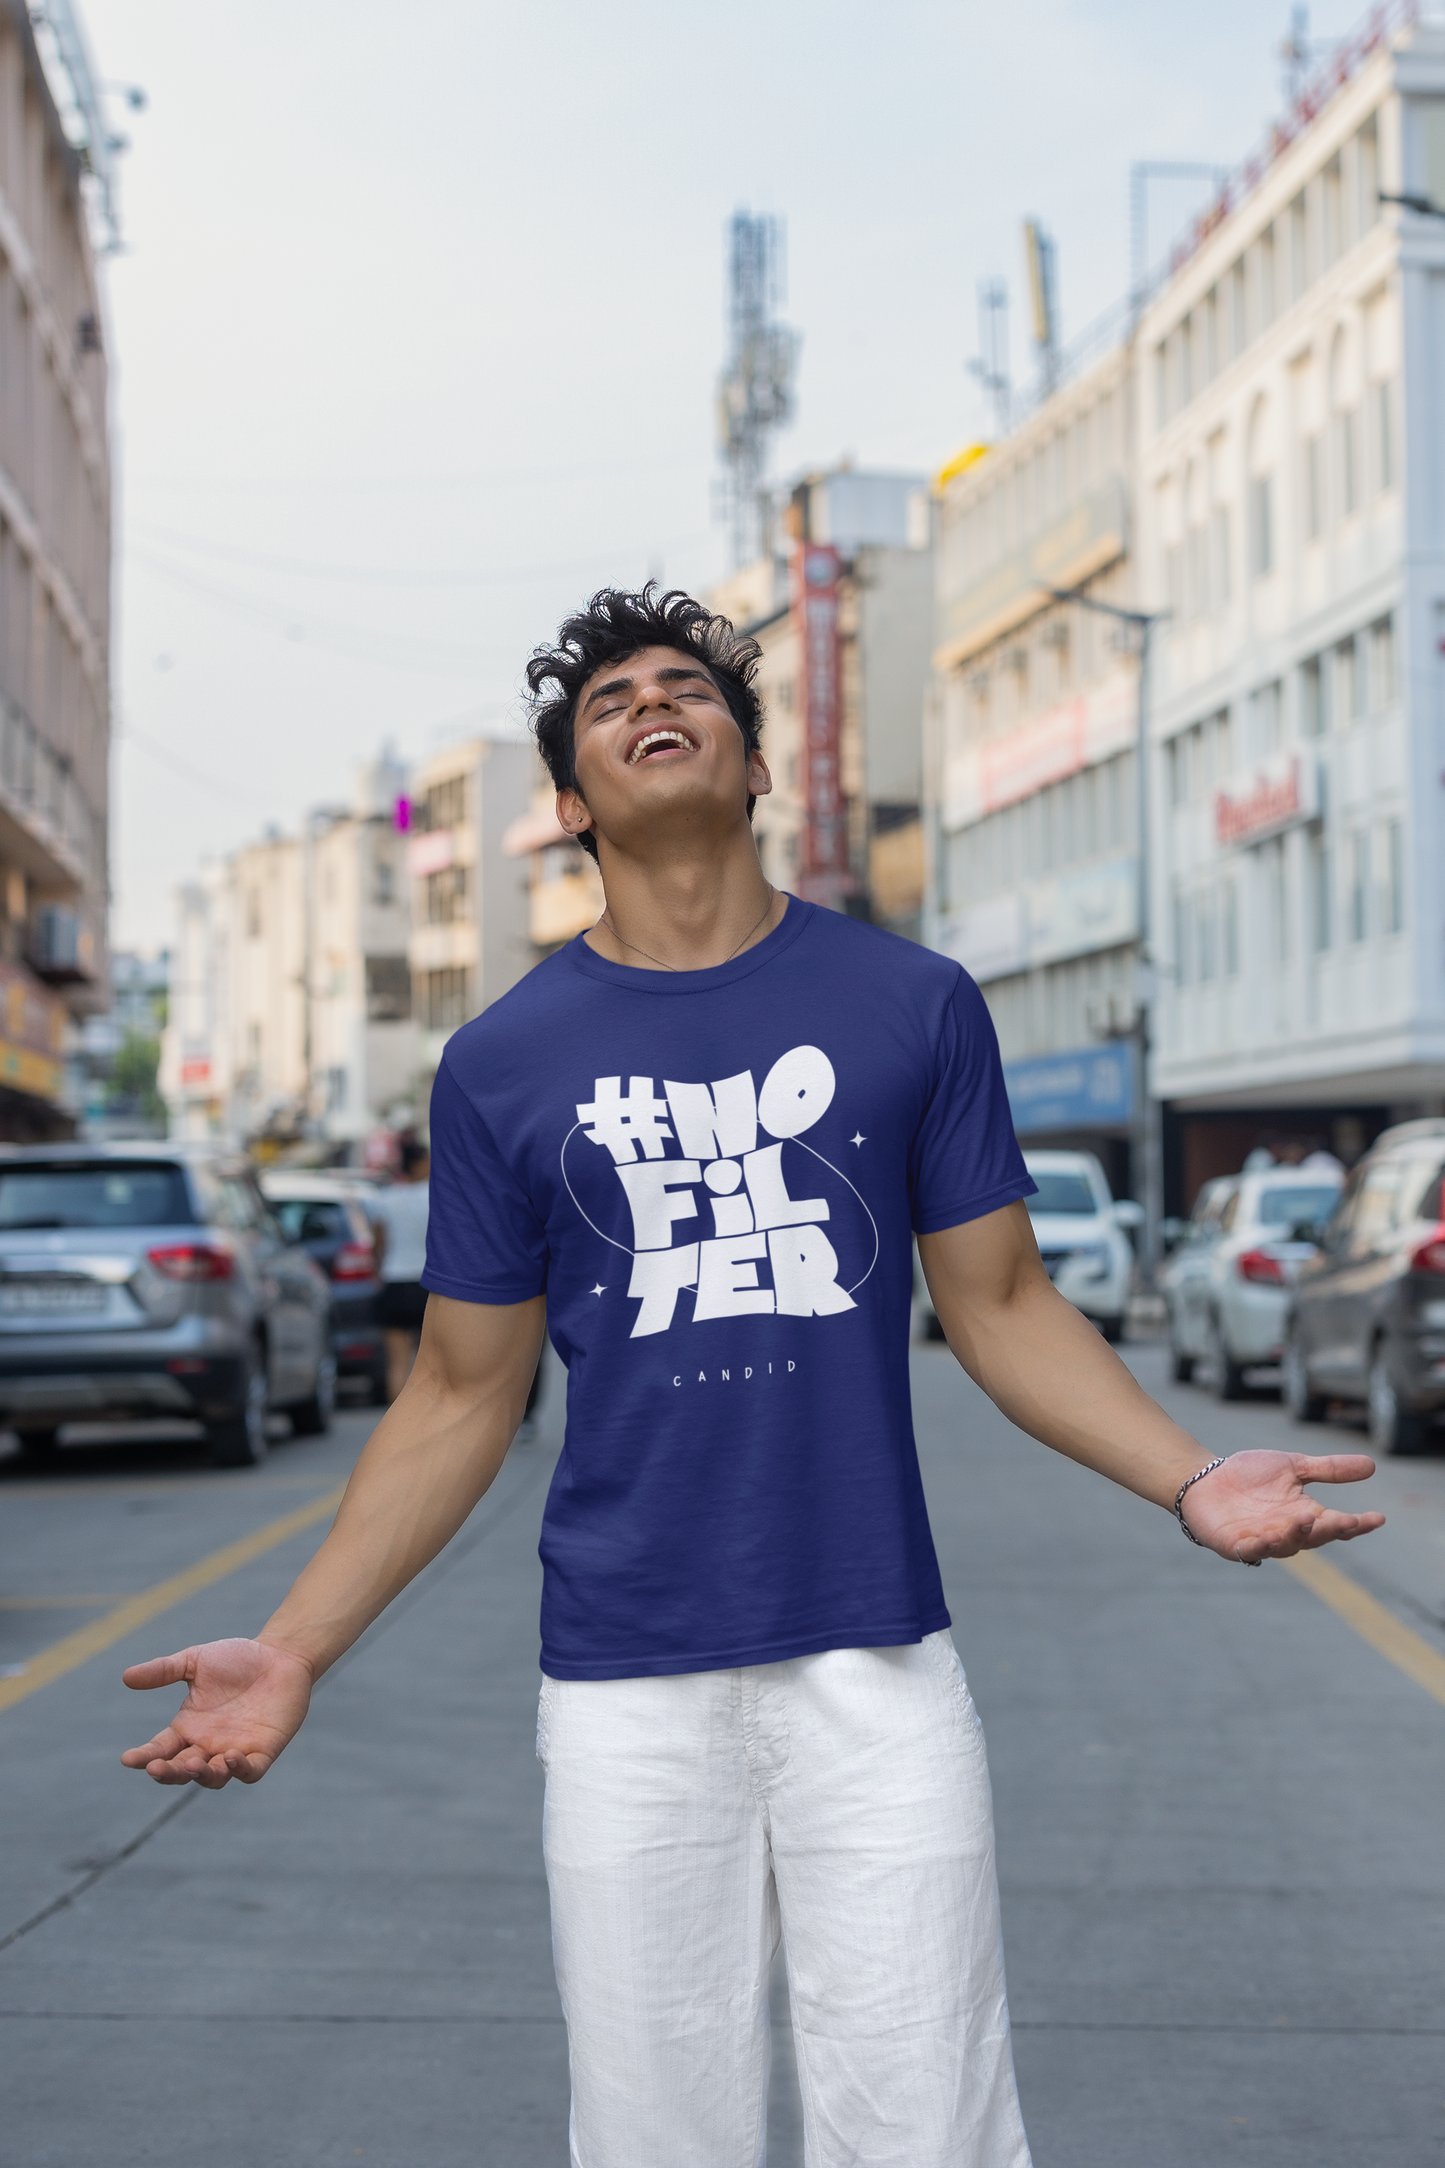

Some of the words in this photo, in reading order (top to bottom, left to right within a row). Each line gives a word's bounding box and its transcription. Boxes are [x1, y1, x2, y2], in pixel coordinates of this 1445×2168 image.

[576, 1045, 836, 1165] #NO
[627, 1224, 859, 1339] TER
[673, 1360, 796, 1387] CANDID
